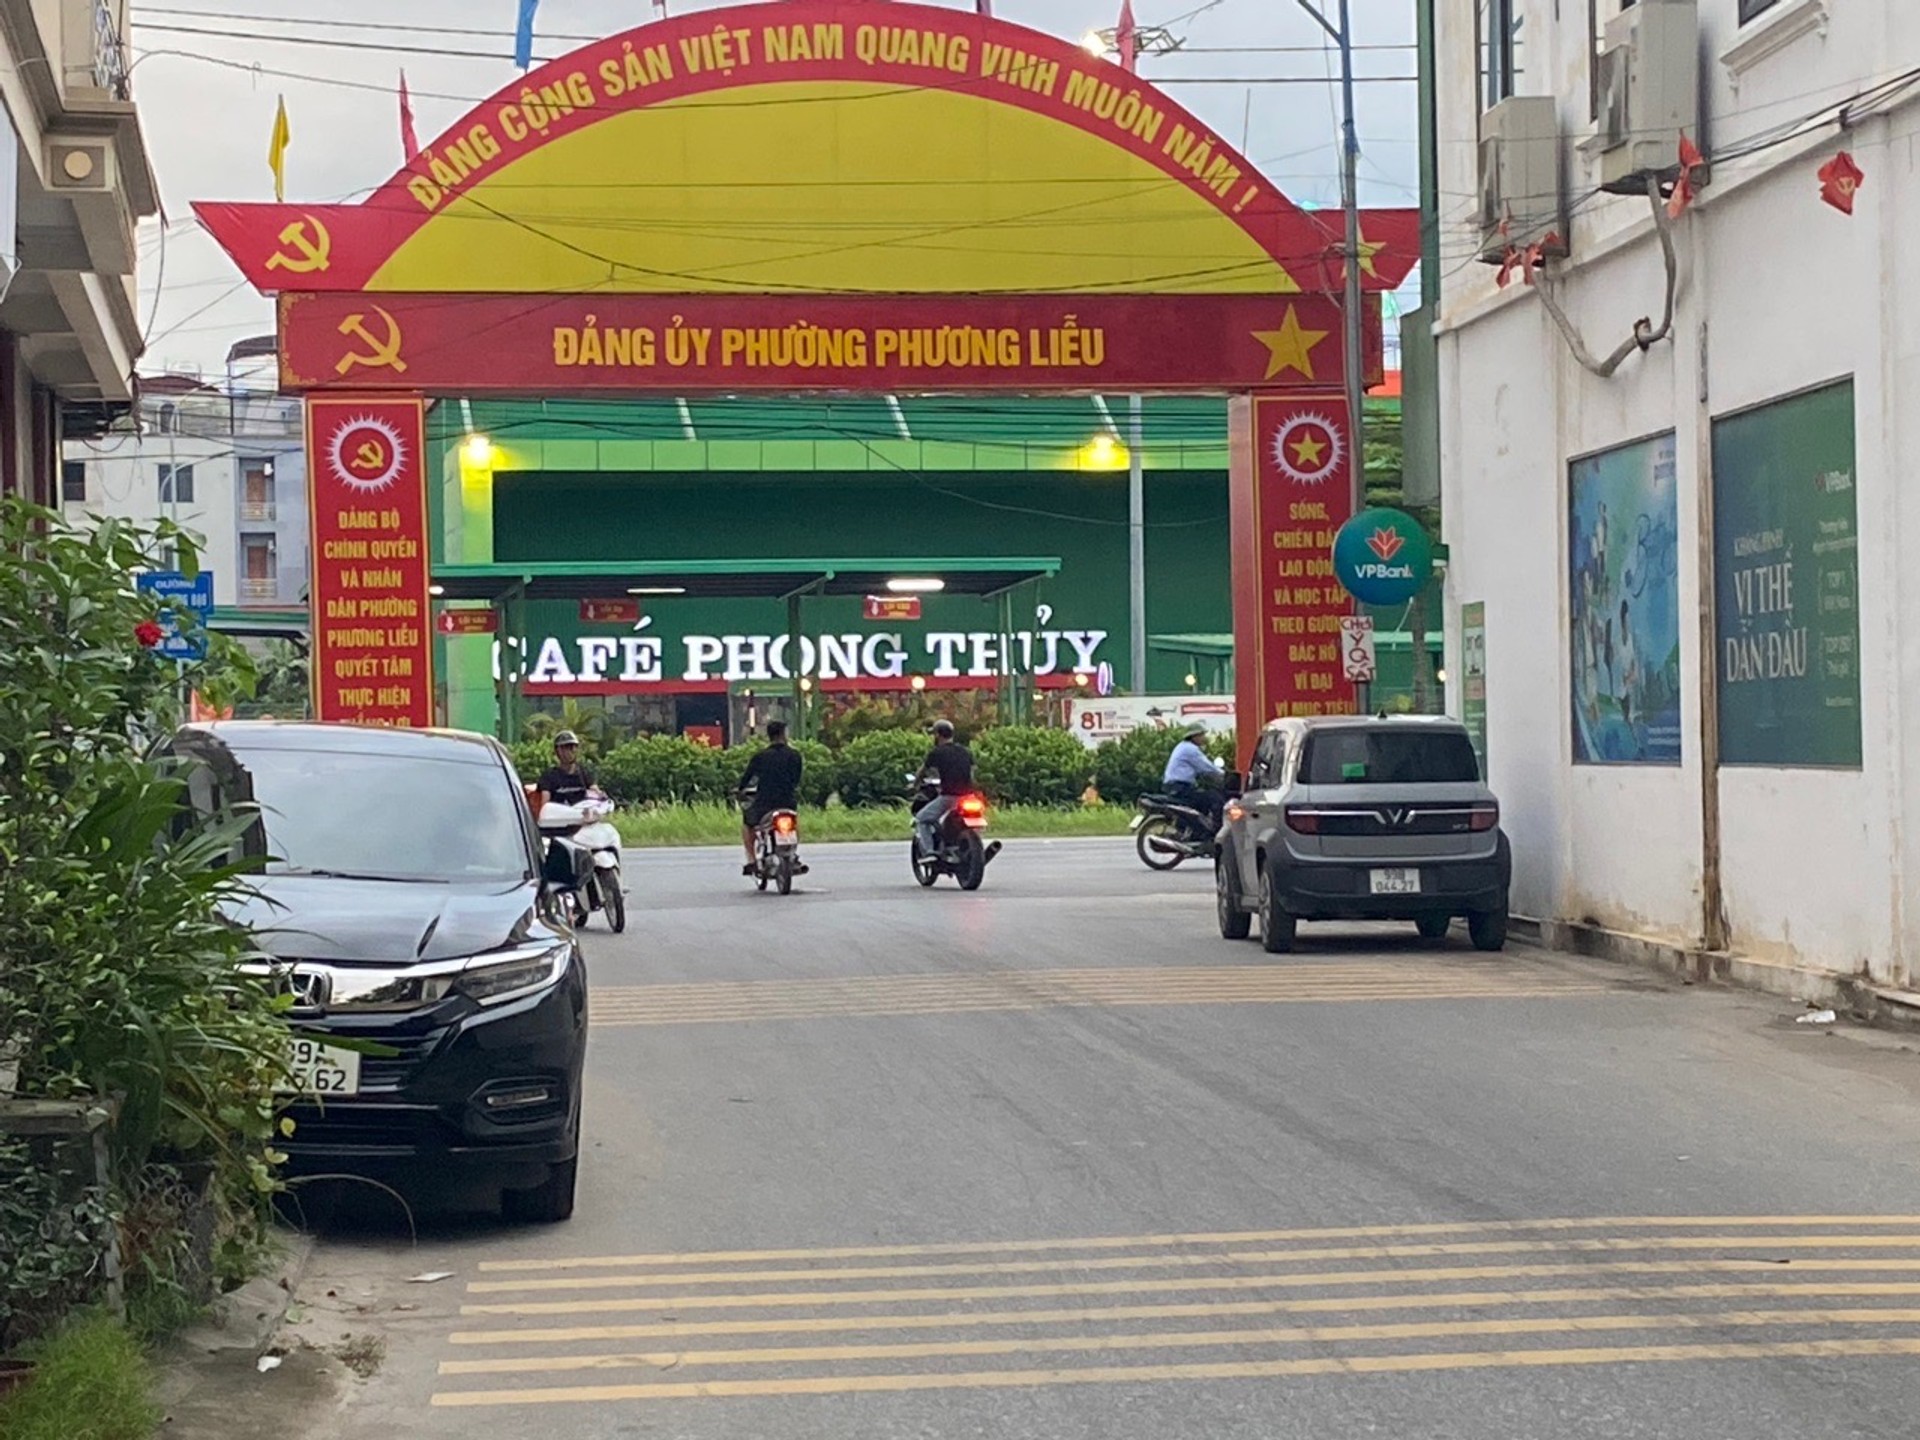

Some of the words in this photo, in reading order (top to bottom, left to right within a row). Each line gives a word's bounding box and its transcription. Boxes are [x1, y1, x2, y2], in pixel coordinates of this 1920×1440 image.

[407, 123, 501, 213] ĐẢNG
[498, 73, 596, 136] CỘNG
[599, 41, 675, 99] SẢN
[679, 24, 751, 78] VIỆT
[763, 24, 843, 63] NAM
[855, 24, 970, 74] QUANG
[1063, 69, 1165, 143] MUÔN
[1162, 123, 1242, 199] NĂM
[553, 314, 656, 366] ĐẢNG
[665, 314, 712, 366] ỦY
[721, 319, 867, 367] PHƯỜNG
[875, 325, 1020, 367] PHƯƠNG
[1029, 314, 1105, 366] LIỄU
[381, 506, 400, 532] BỘ
[341, 566, 359, 588] VÀ
[1279, 559, 1303, 577] LAO
[1354, 563, 1414, 579] VPBank
[1273, 585, 1291, 605] VÀ
[1271, 615, 1304, 634] THEO
[491, 615, 663, 683] CAFÉ
[682, 633, 908, 682] PHONG
[926, 603, 1108, 677] THỦY
[1081, 711, 1103, 730] 81
